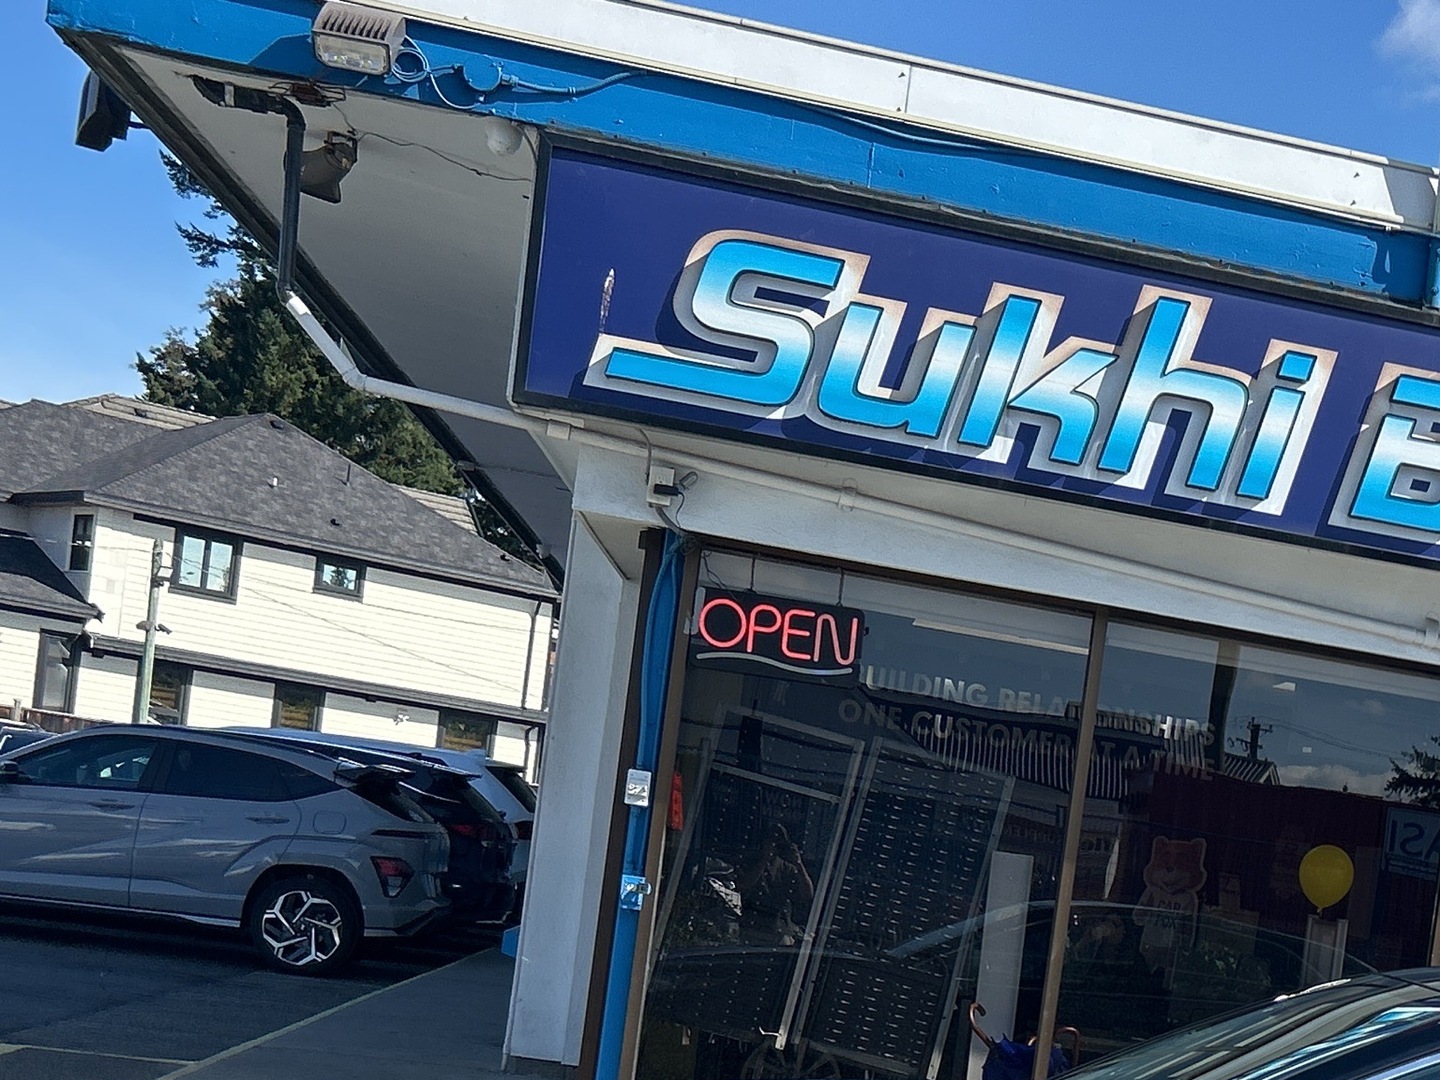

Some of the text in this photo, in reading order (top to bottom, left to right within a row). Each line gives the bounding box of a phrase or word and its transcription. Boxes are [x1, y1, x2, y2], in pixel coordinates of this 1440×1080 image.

[583, 229, 1339, 516] Sukhi
[699, 598, 858, 666] OPEN
[838, 698, 903, 730] ONE
[911, 711, 1073, 757] CUSTOMER
[1122, 746, 1142, 768] A
[1150, 749, 1216, 782] TIME
[998, 688, 1216, 746] RELATONSHIPS
